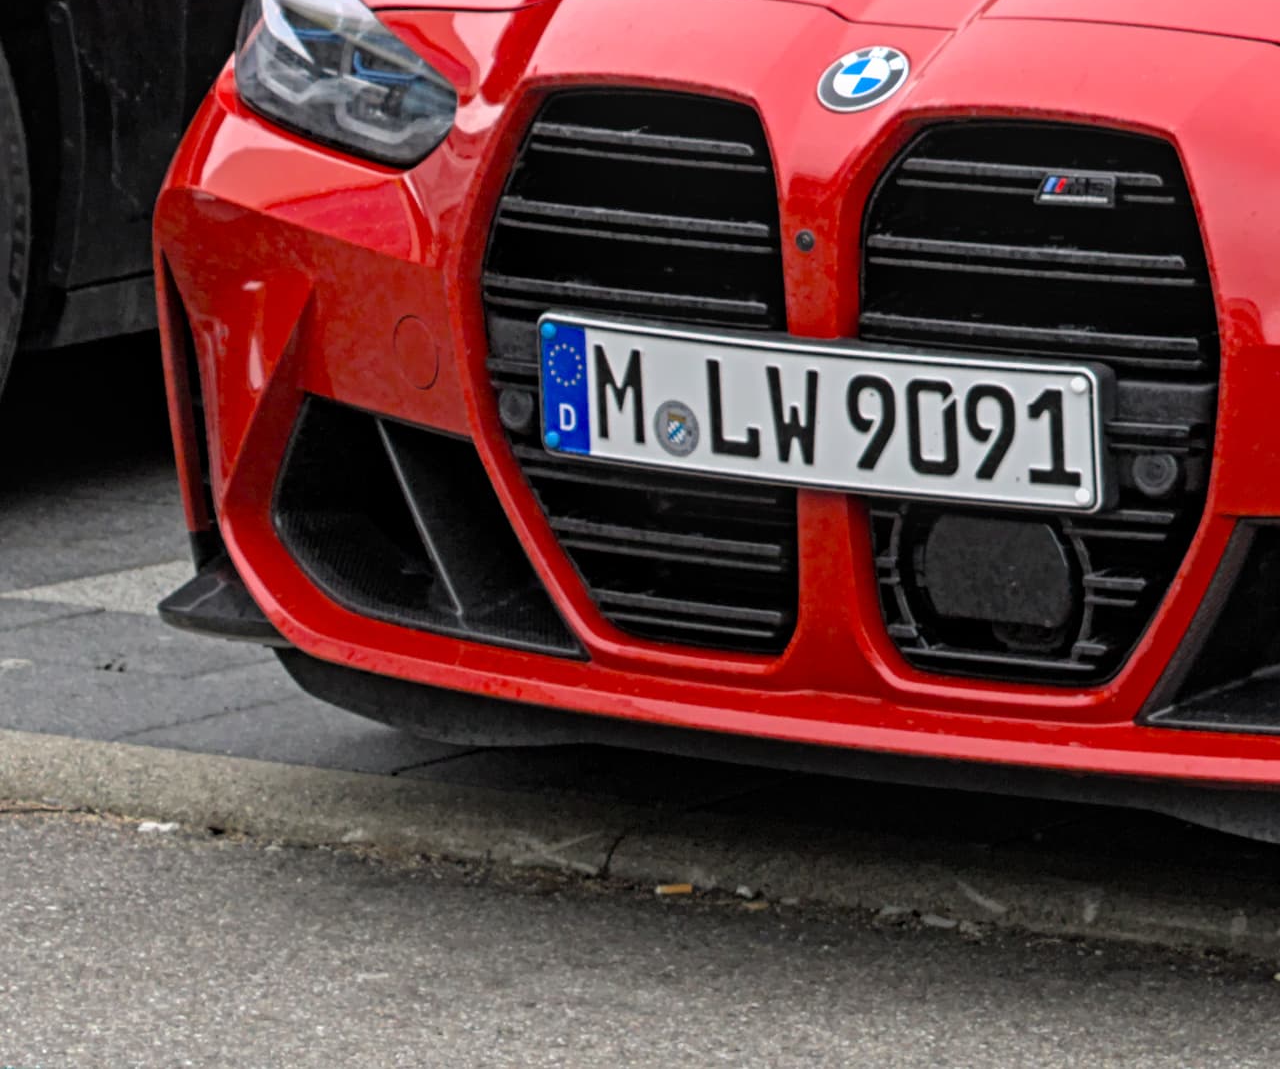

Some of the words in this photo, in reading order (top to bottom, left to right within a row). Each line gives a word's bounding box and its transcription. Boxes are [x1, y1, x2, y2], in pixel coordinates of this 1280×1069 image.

[558, 402, 577, 432] D
[594, 344, 646, 444] M
[706, 358, 820, 466] LW
[847, 374, 1083, 486] 9091
